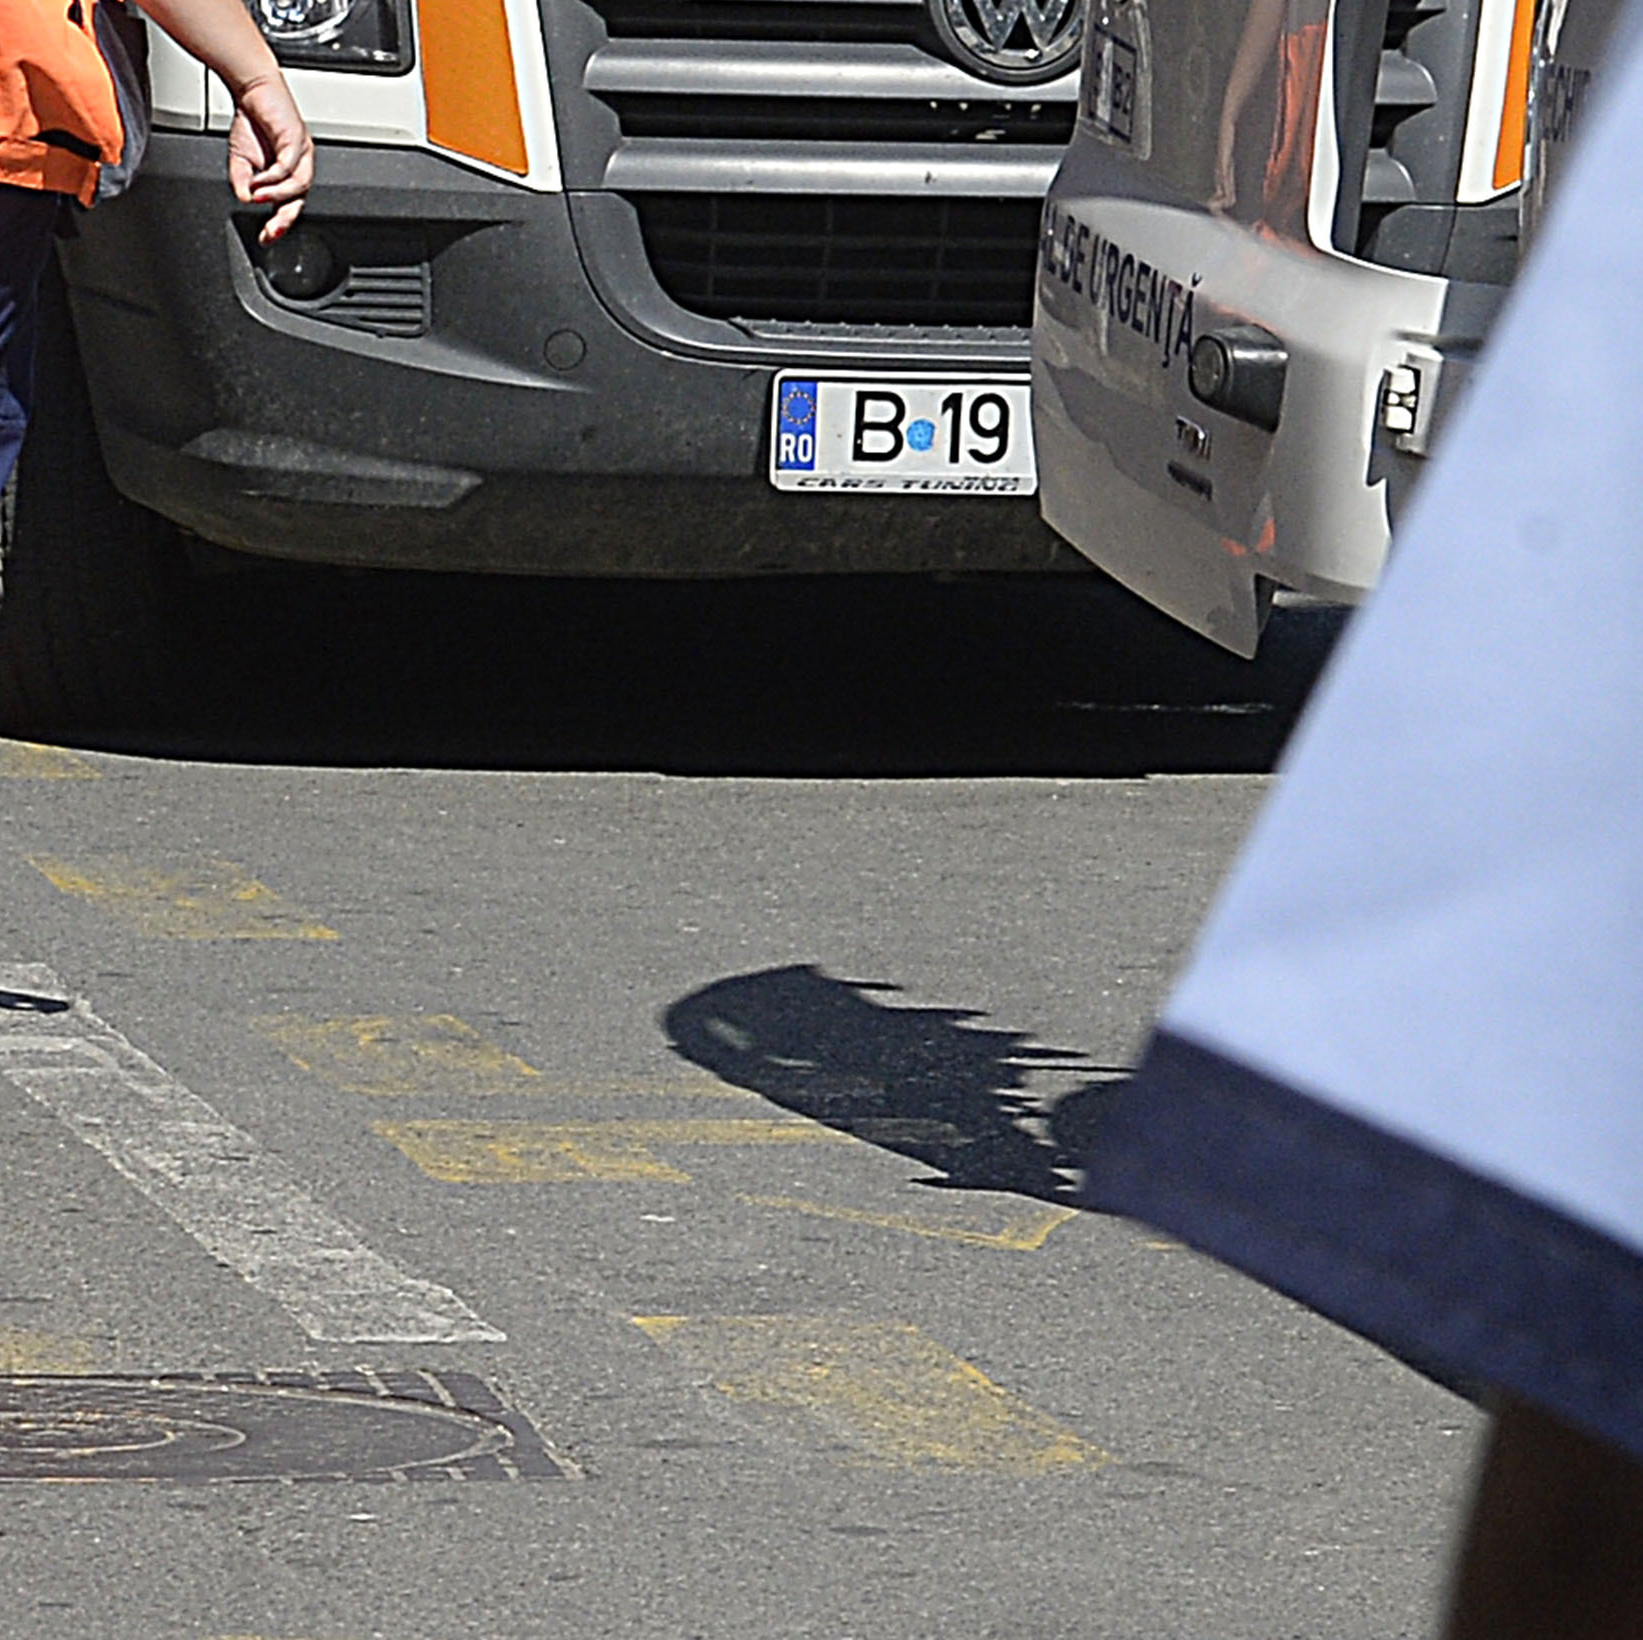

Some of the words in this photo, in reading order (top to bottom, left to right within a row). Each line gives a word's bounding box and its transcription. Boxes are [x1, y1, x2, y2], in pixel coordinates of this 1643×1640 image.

[779, 434, 813, 463] RO
[852, 390, 906, 462] B
[941, 392, 1010, 464] 19
